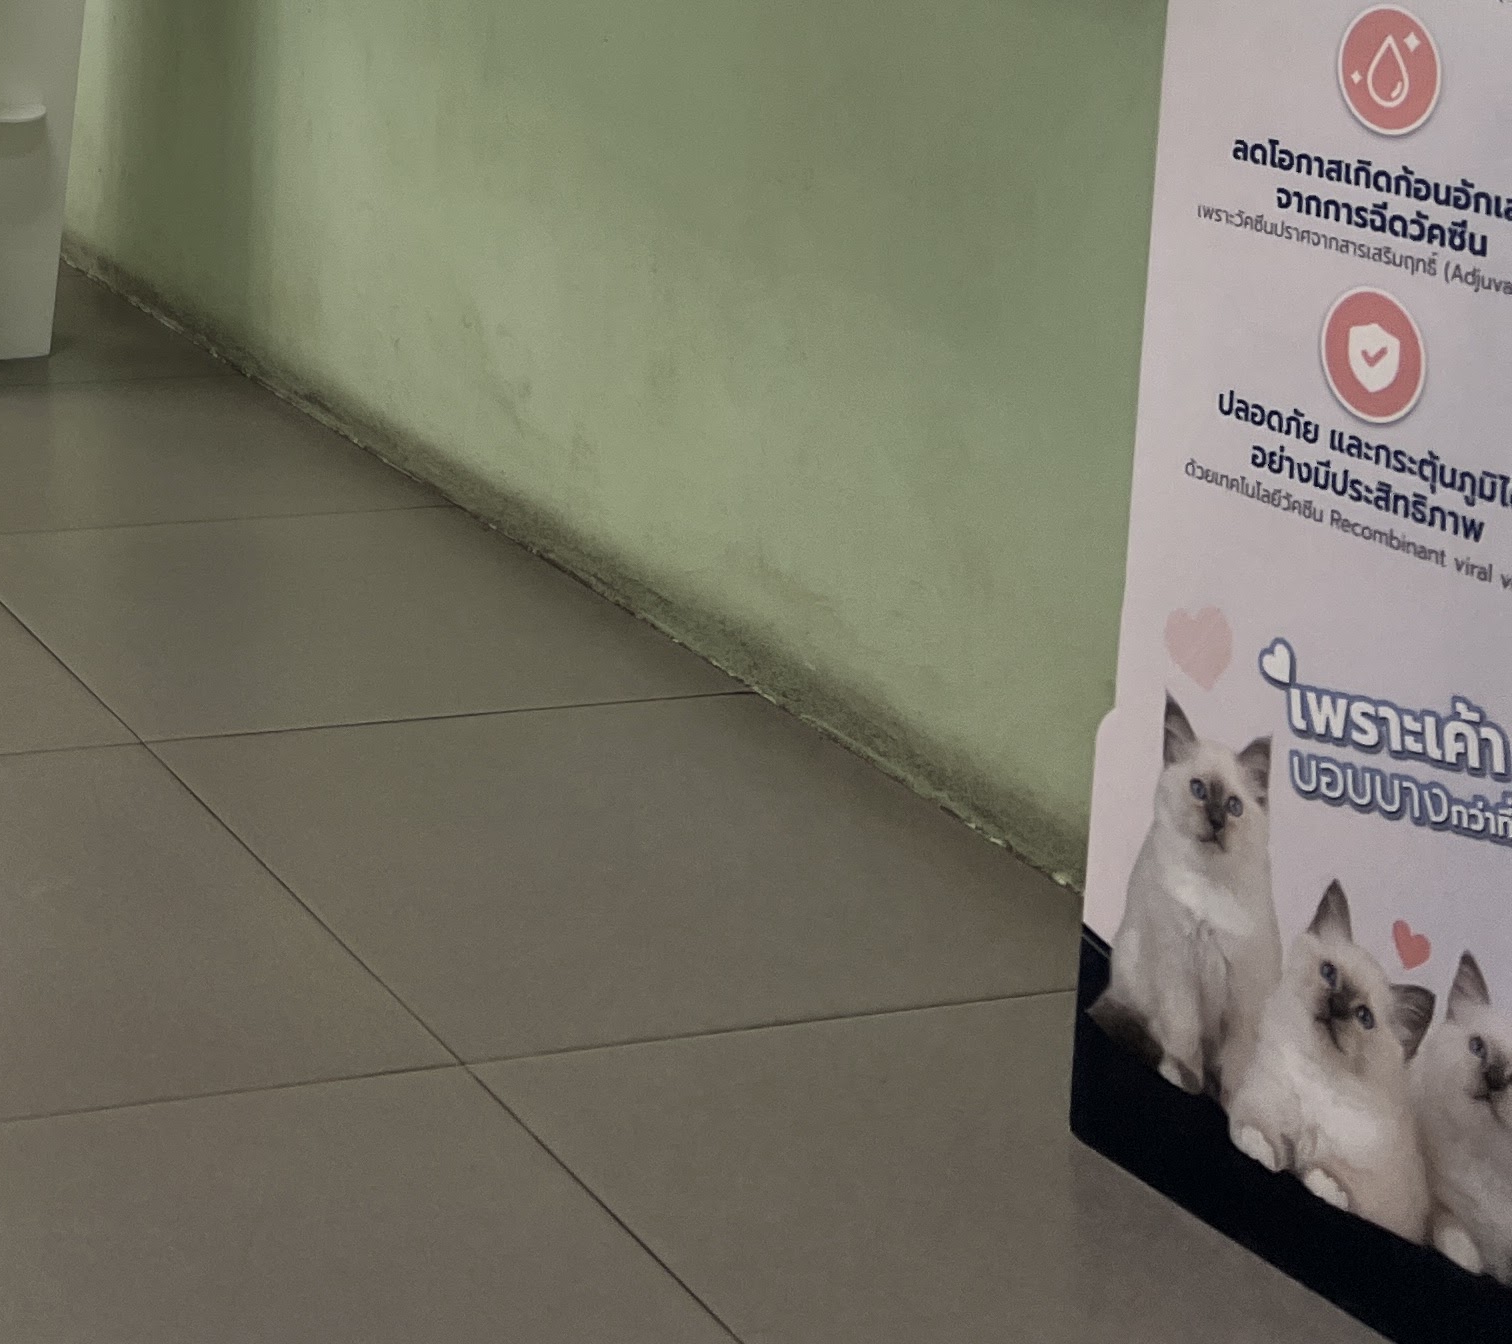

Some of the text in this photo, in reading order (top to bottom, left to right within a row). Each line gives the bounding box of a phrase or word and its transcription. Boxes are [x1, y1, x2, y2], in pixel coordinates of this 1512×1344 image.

[1275, 186, 1488, 257] จากการฉีดวัคซีน
[1219, 389, 1512, 508] ปลอดภัย และกระตุ้นภูมิไ
[1250, 444, 1485, 543] อย่างมีประสิทธิภาพ
[1184, 458, 1492, 583] ด้วยเทคโนโลยีวัคซีน Recombinant viral
[1289, 687, 1508, 775] เพราะเค้า
